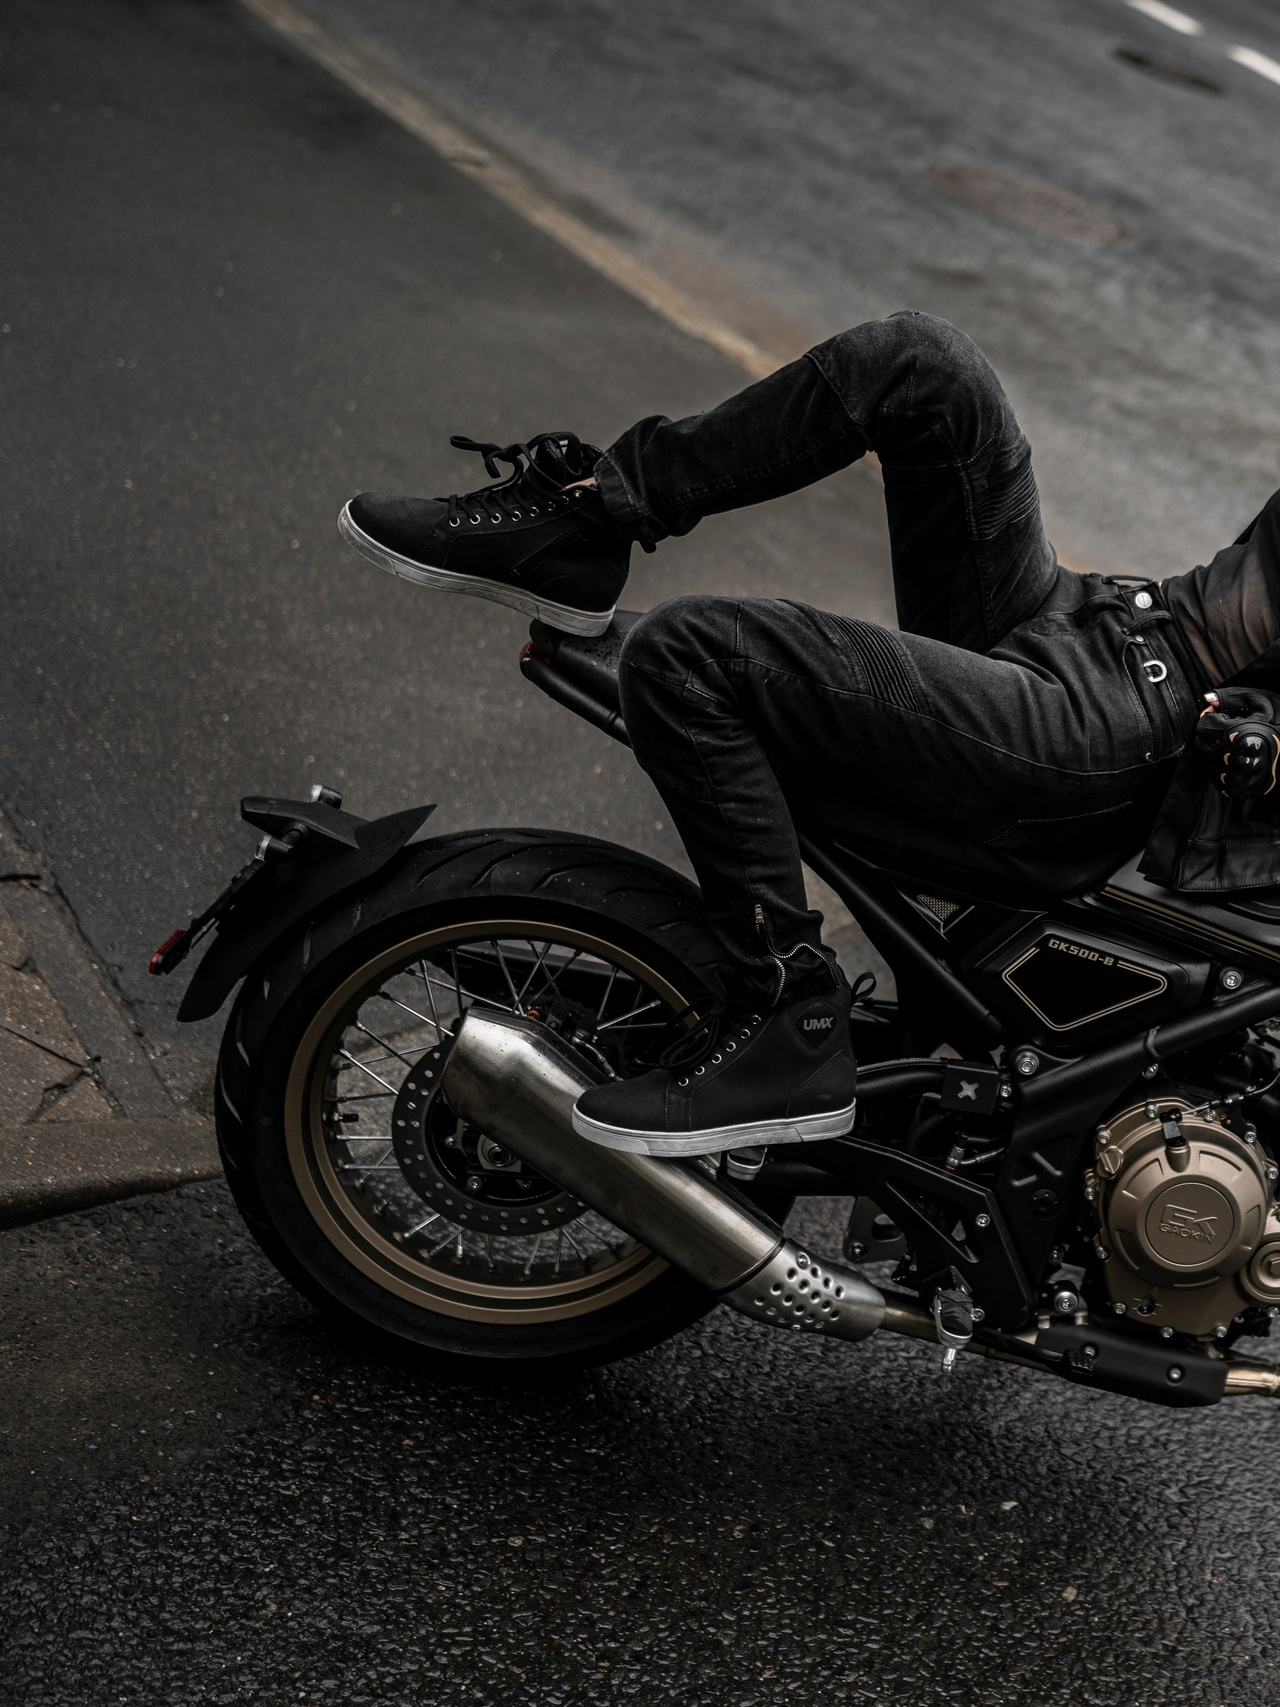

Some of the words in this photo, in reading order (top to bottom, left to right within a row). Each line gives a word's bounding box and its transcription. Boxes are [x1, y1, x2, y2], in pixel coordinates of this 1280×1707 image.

[1047, 938, 1115, 967] GK500-B
[803, 1016, 834, 1031] UMX
[1160, 1203, 1218, 1237] GK
[1159, 1222, 1215, 1244] GAOKIN
